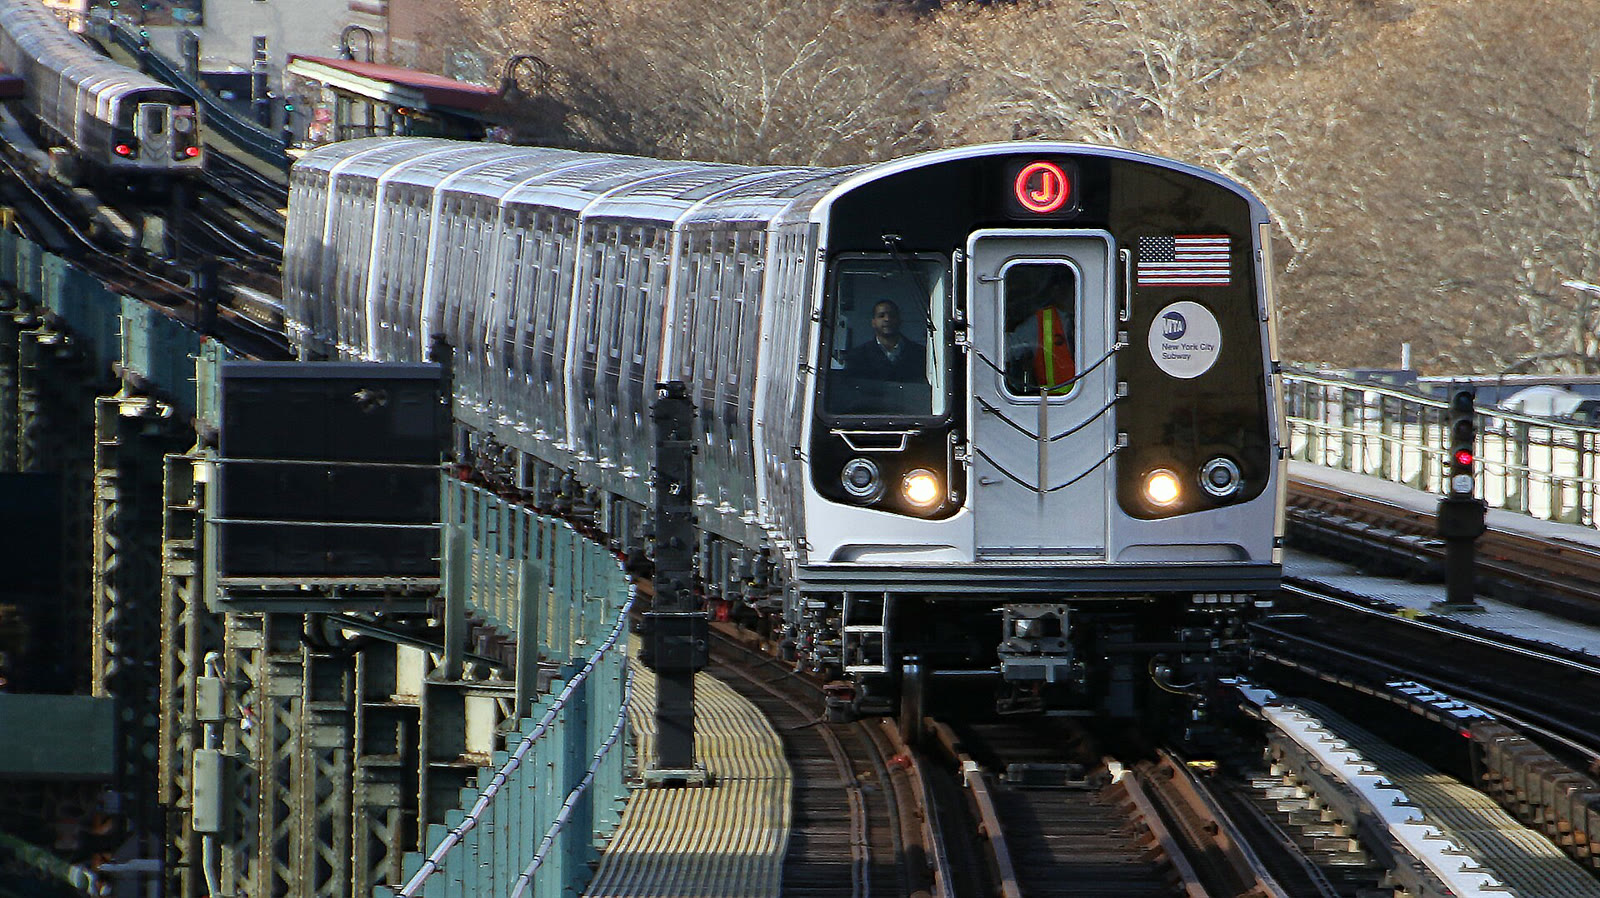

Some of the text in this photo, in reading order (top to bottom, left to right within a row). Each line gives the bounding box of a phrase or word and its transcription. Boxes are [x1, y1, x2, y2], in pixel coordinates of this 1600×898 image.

[1030, 171, 1055, 203] J
[1162, 317, 1183, 335] MTA
[1161, 343, 1215, 352] New York City
[1162, 352, 1191, 361] Subway
